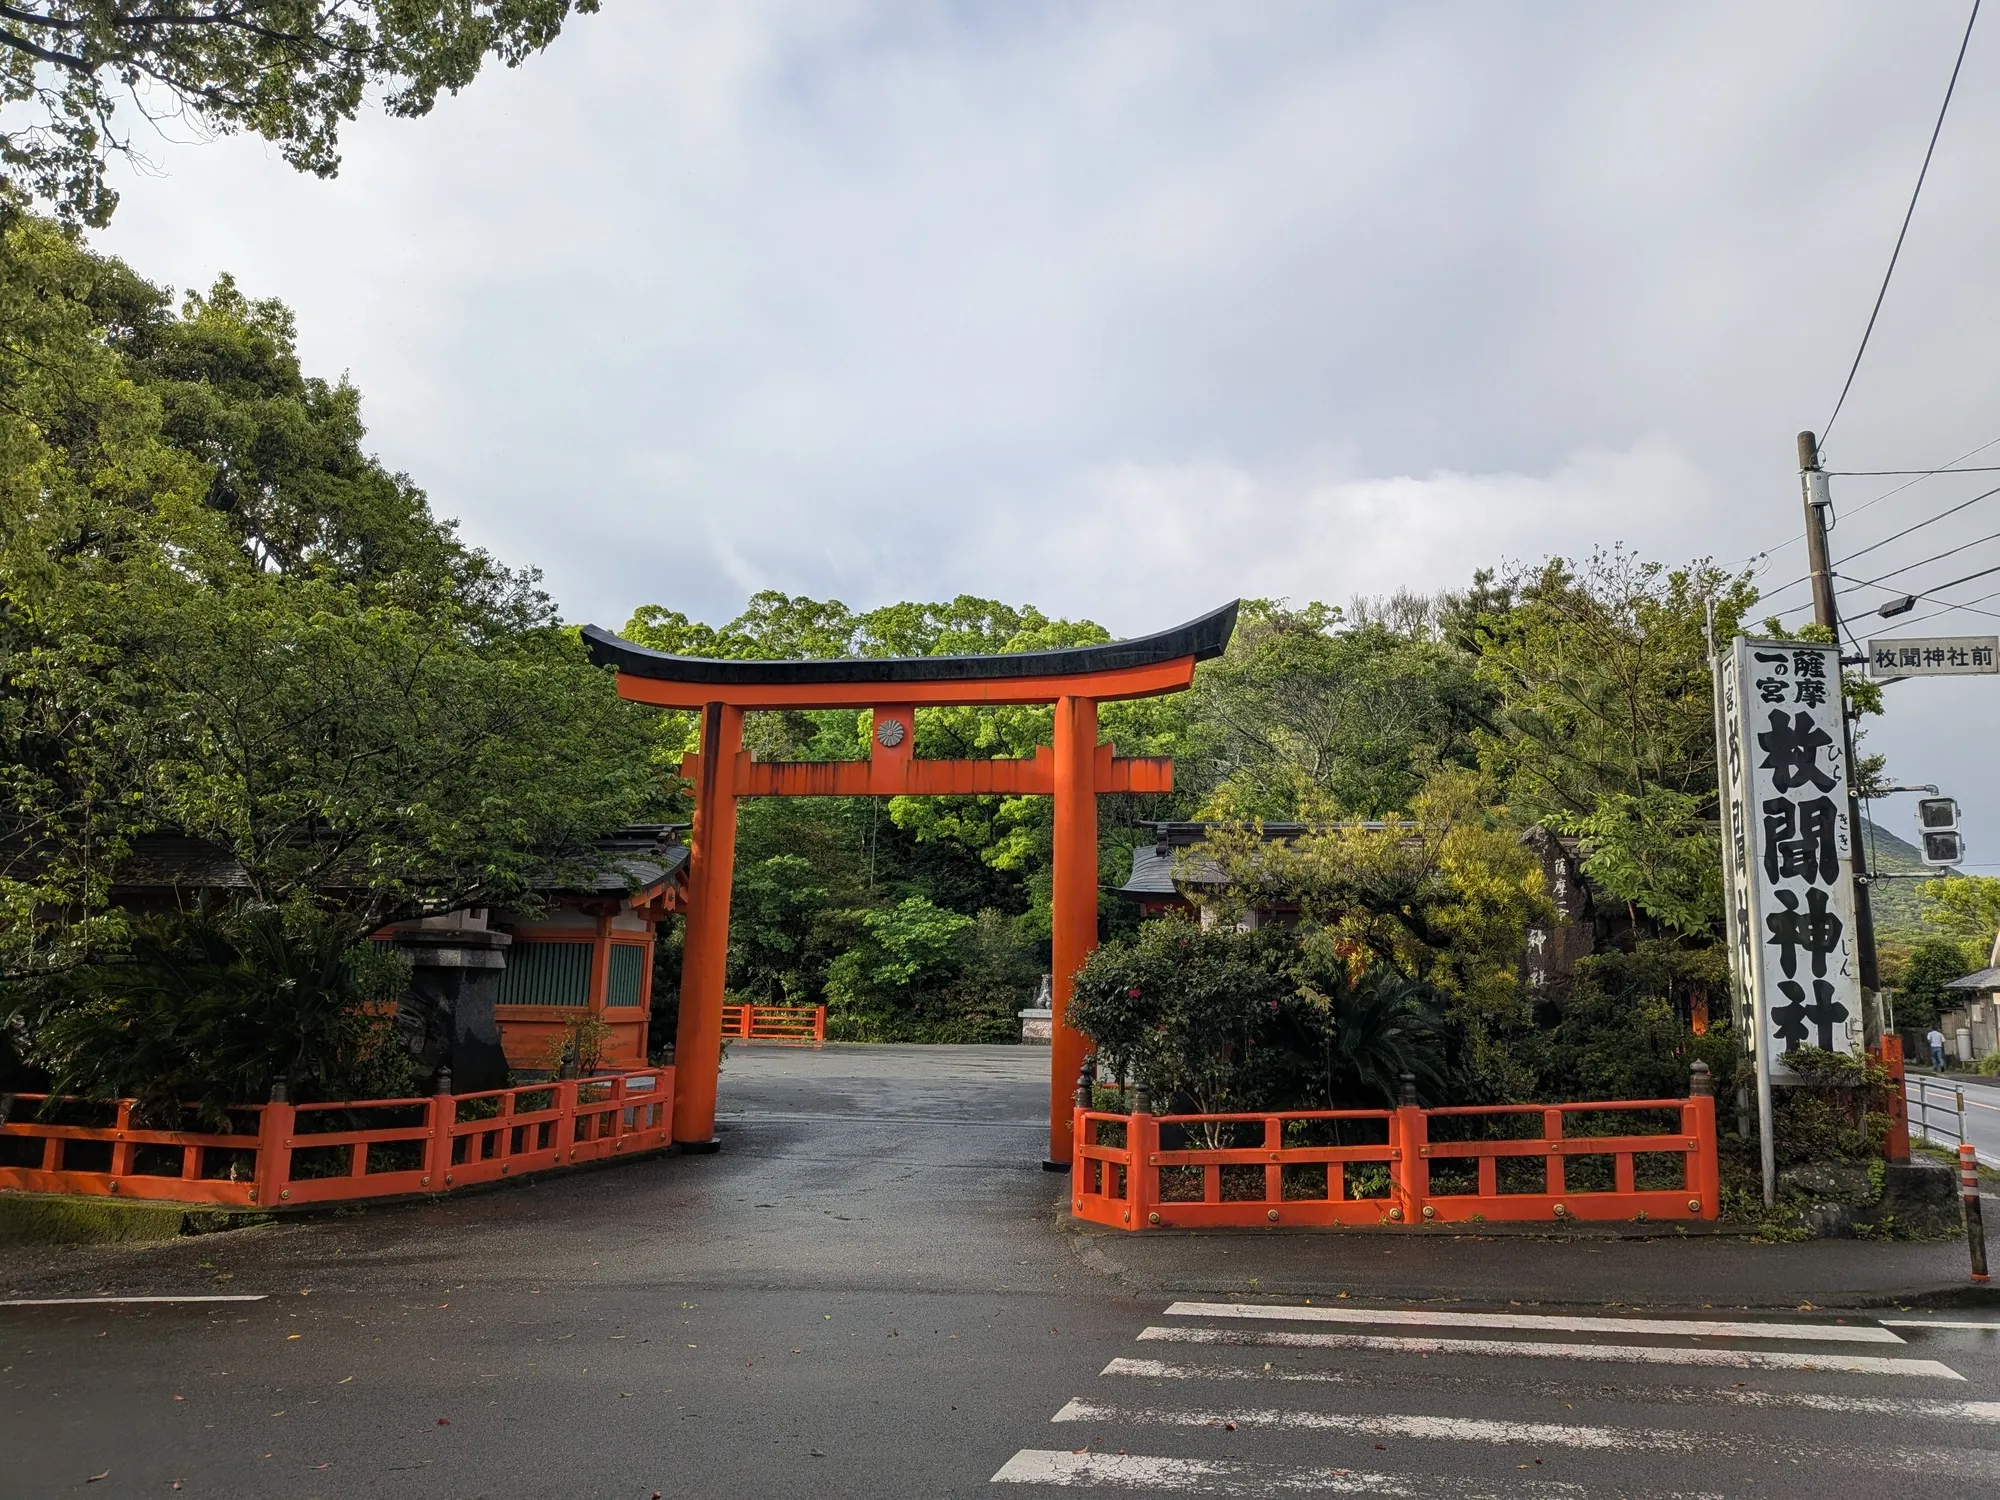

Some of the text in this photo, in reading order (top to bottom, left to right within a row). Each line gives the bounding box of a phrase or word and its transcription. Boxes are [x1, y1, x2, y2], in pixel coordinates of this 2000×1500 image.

[1754, 652, 1790, 703] 一の宮
[1792, 650, 1827, 709] 薩摩
[1875, 645, 1993, 668] 枚聞神社前
[1827, 745, 1843, 783] ひら
[1837, 812, 1849, 851] きき
[1757, 708, 1850, 1054] 枚聞神社
